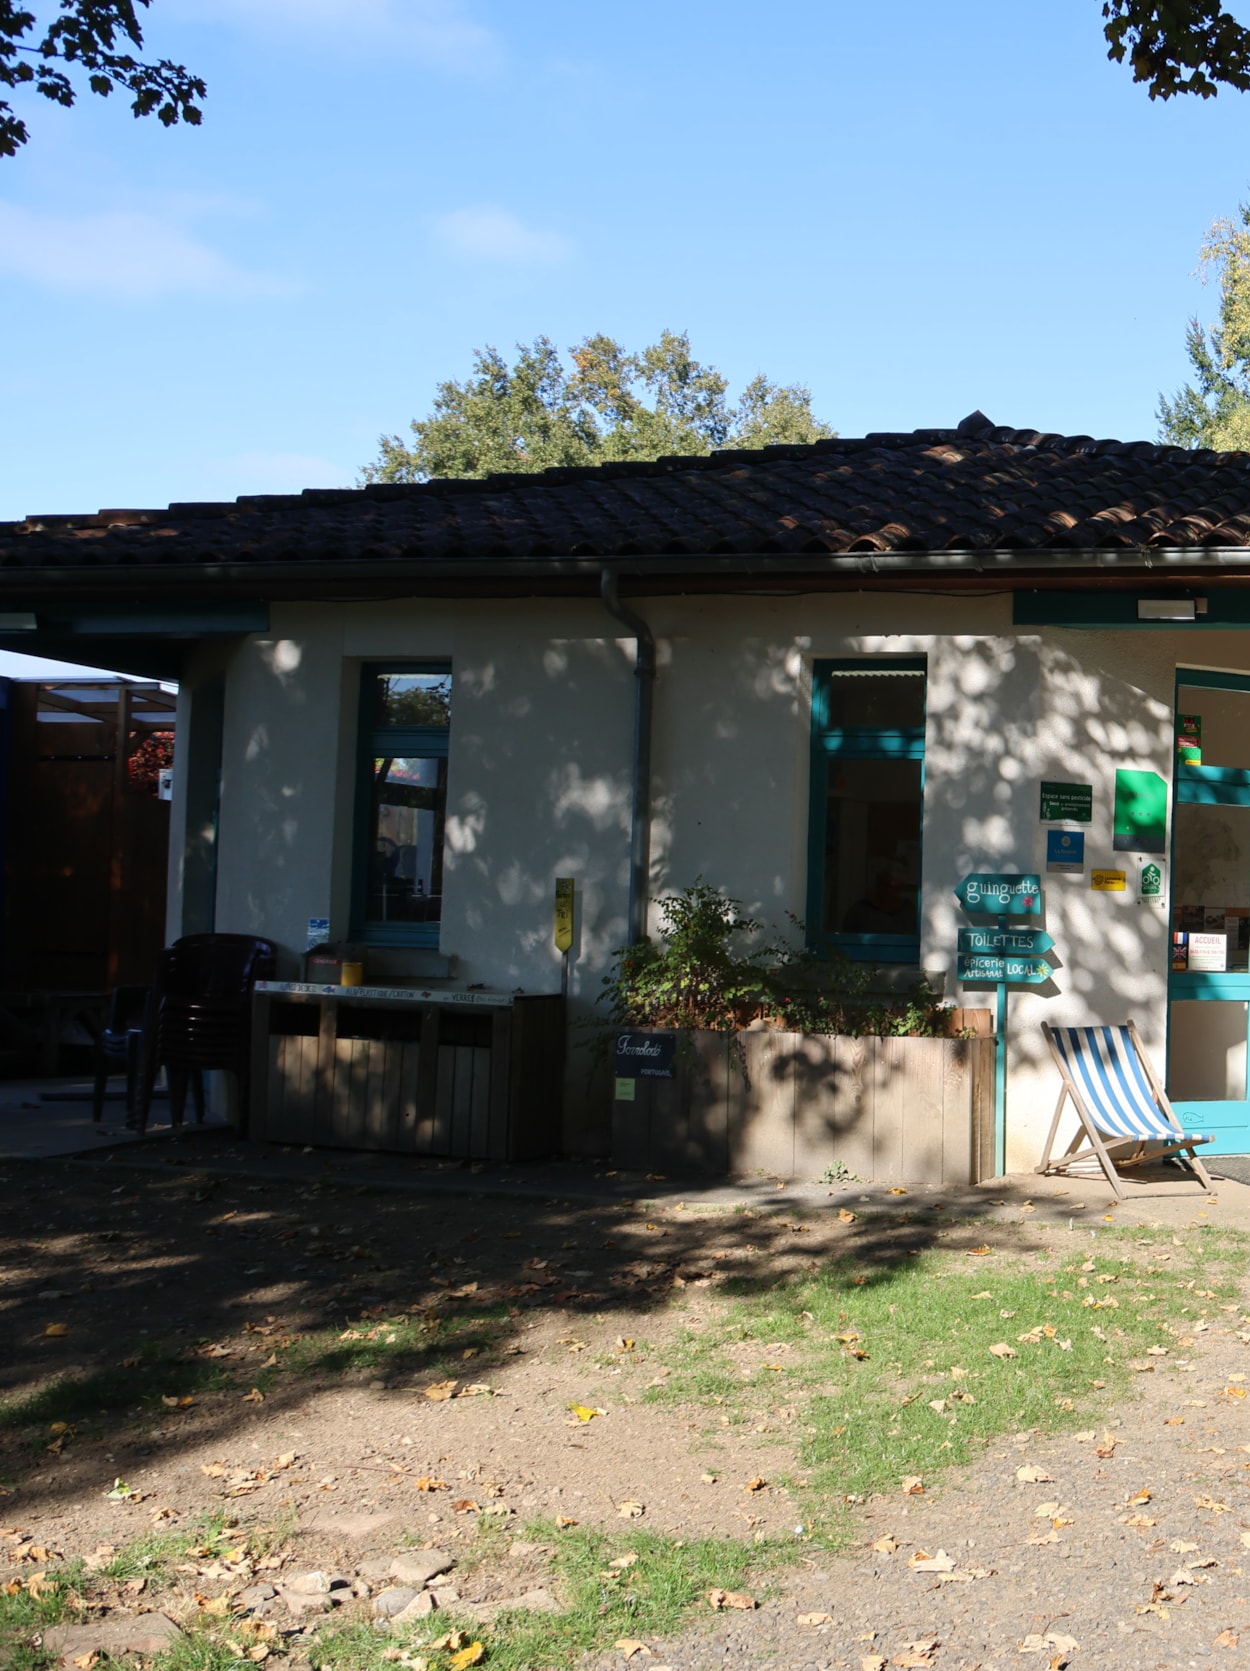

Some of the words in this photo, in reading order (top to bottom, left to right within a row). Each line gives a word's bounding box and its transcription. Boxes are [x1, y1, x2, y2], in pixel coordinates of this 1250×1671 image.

[1042, 792, 1058, 800] Espace
[967, 880, 1038, 903] guinguette
[1195, 936, 1221, 945] ACCUEIL
[964, 957, 1005, 968] épicerie
[1007, 963, 1037, 977] LOCAL
